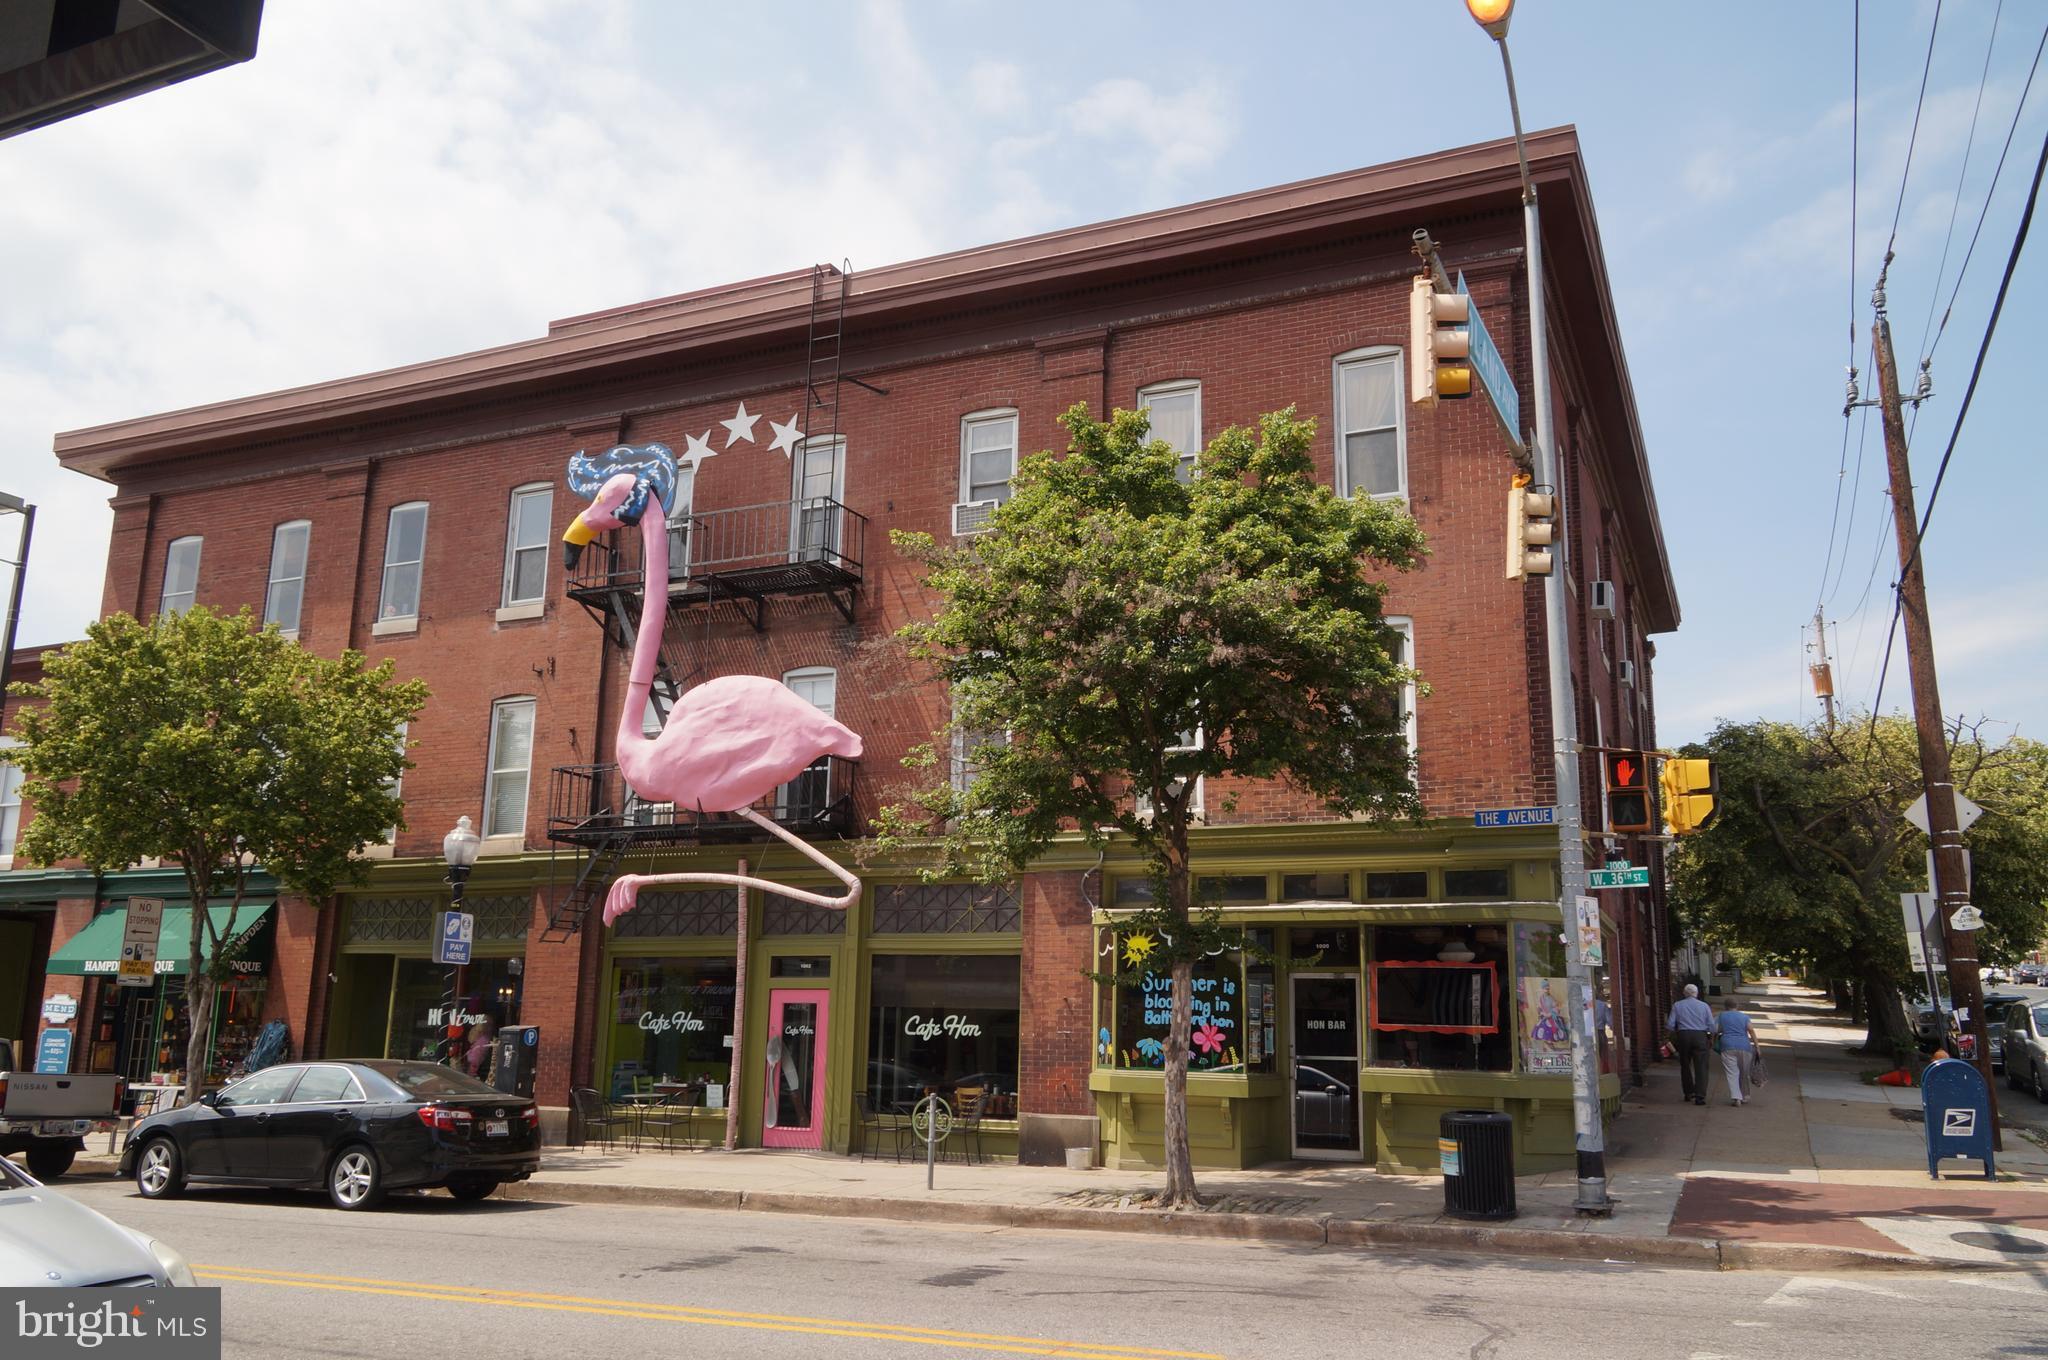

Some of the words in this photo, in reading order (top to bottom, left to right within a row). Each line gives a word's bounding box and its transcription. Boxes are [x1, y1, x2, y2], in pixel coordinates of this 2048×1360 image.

[1479, 812, 1499, 825] THE
[1507, 807, 1550, 824] AVENUE
[1609, 860, 1628, 870] 1000
[1592, 873, 1606, 885] W.
[1610, 872, 1632, 885] 36TH
[138, 903, 152, 912] NO
[128, 915, 159, 926] STOPPING
[449, 943, 464, 951] PAY
[446, 952, 466, 961] HERE
[84, 960, 120, 972] HAMPD
[1223, 977, 1236, 995] is
[45, 1004, 76, 1013] MEND
[1215, 995, 1231, 1012] in
[638, 1011, 672, 1035] Cafe
[671, 1011, 705, 1034] Hon
[1210, 1015, 1235, 1029] hon
[1307, 1020, 1325, 1029] HON
[1327, 1020, 1346, 1030] BAR
[799, 1025, 815, 1035] Hon
[904, 1015, 943, 1042] Cafe
[942, 1015, 982, 1040] Hon
[13, 1083, 48, 1091] NISSAN
